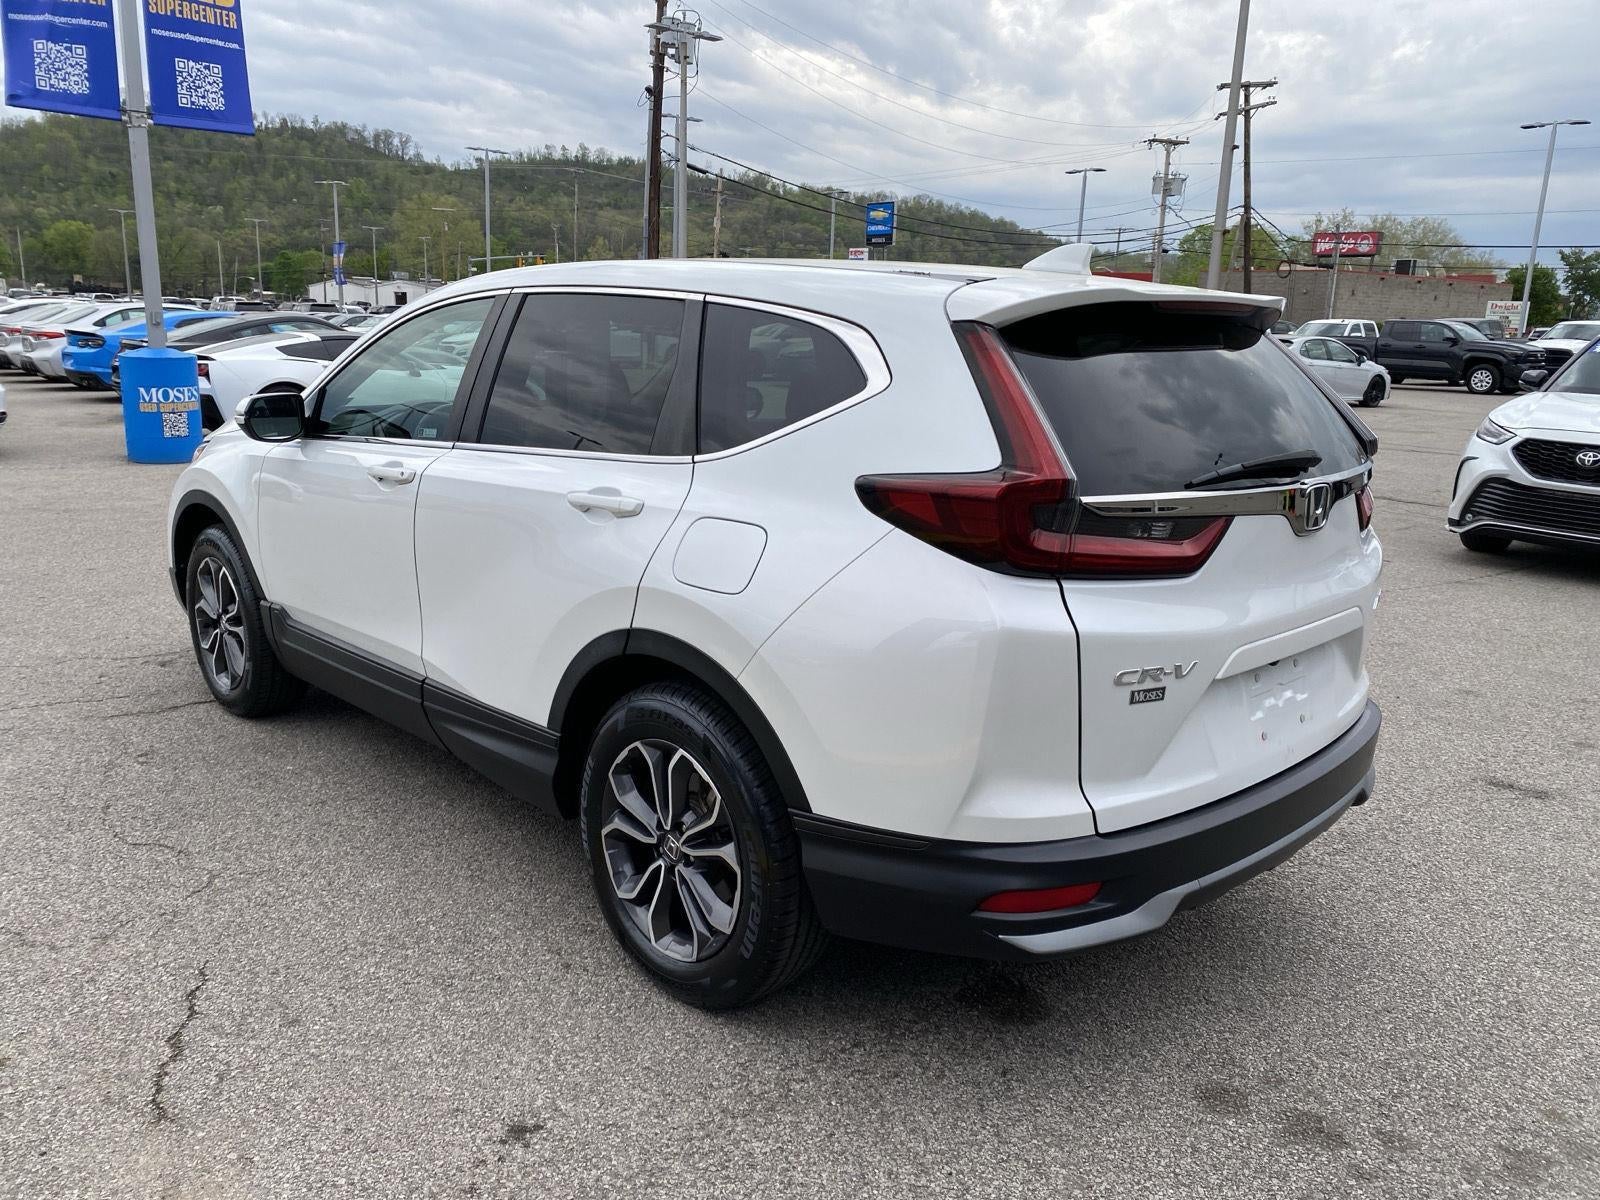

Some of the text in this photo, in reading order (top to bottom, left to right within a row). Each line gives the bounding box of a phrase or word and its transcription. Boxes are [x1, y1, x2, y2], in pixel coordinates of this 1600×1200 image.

[8, 12, 108, 28] mosesusedsupercenter.com
[149, 0, 237, 29] SUPERCENTER
[151, 28, 239, 49] mosesusedsupercenter.com
[138, 386, 199, 402] MOSES
[1113, 660, 1200, 687] CR-V
